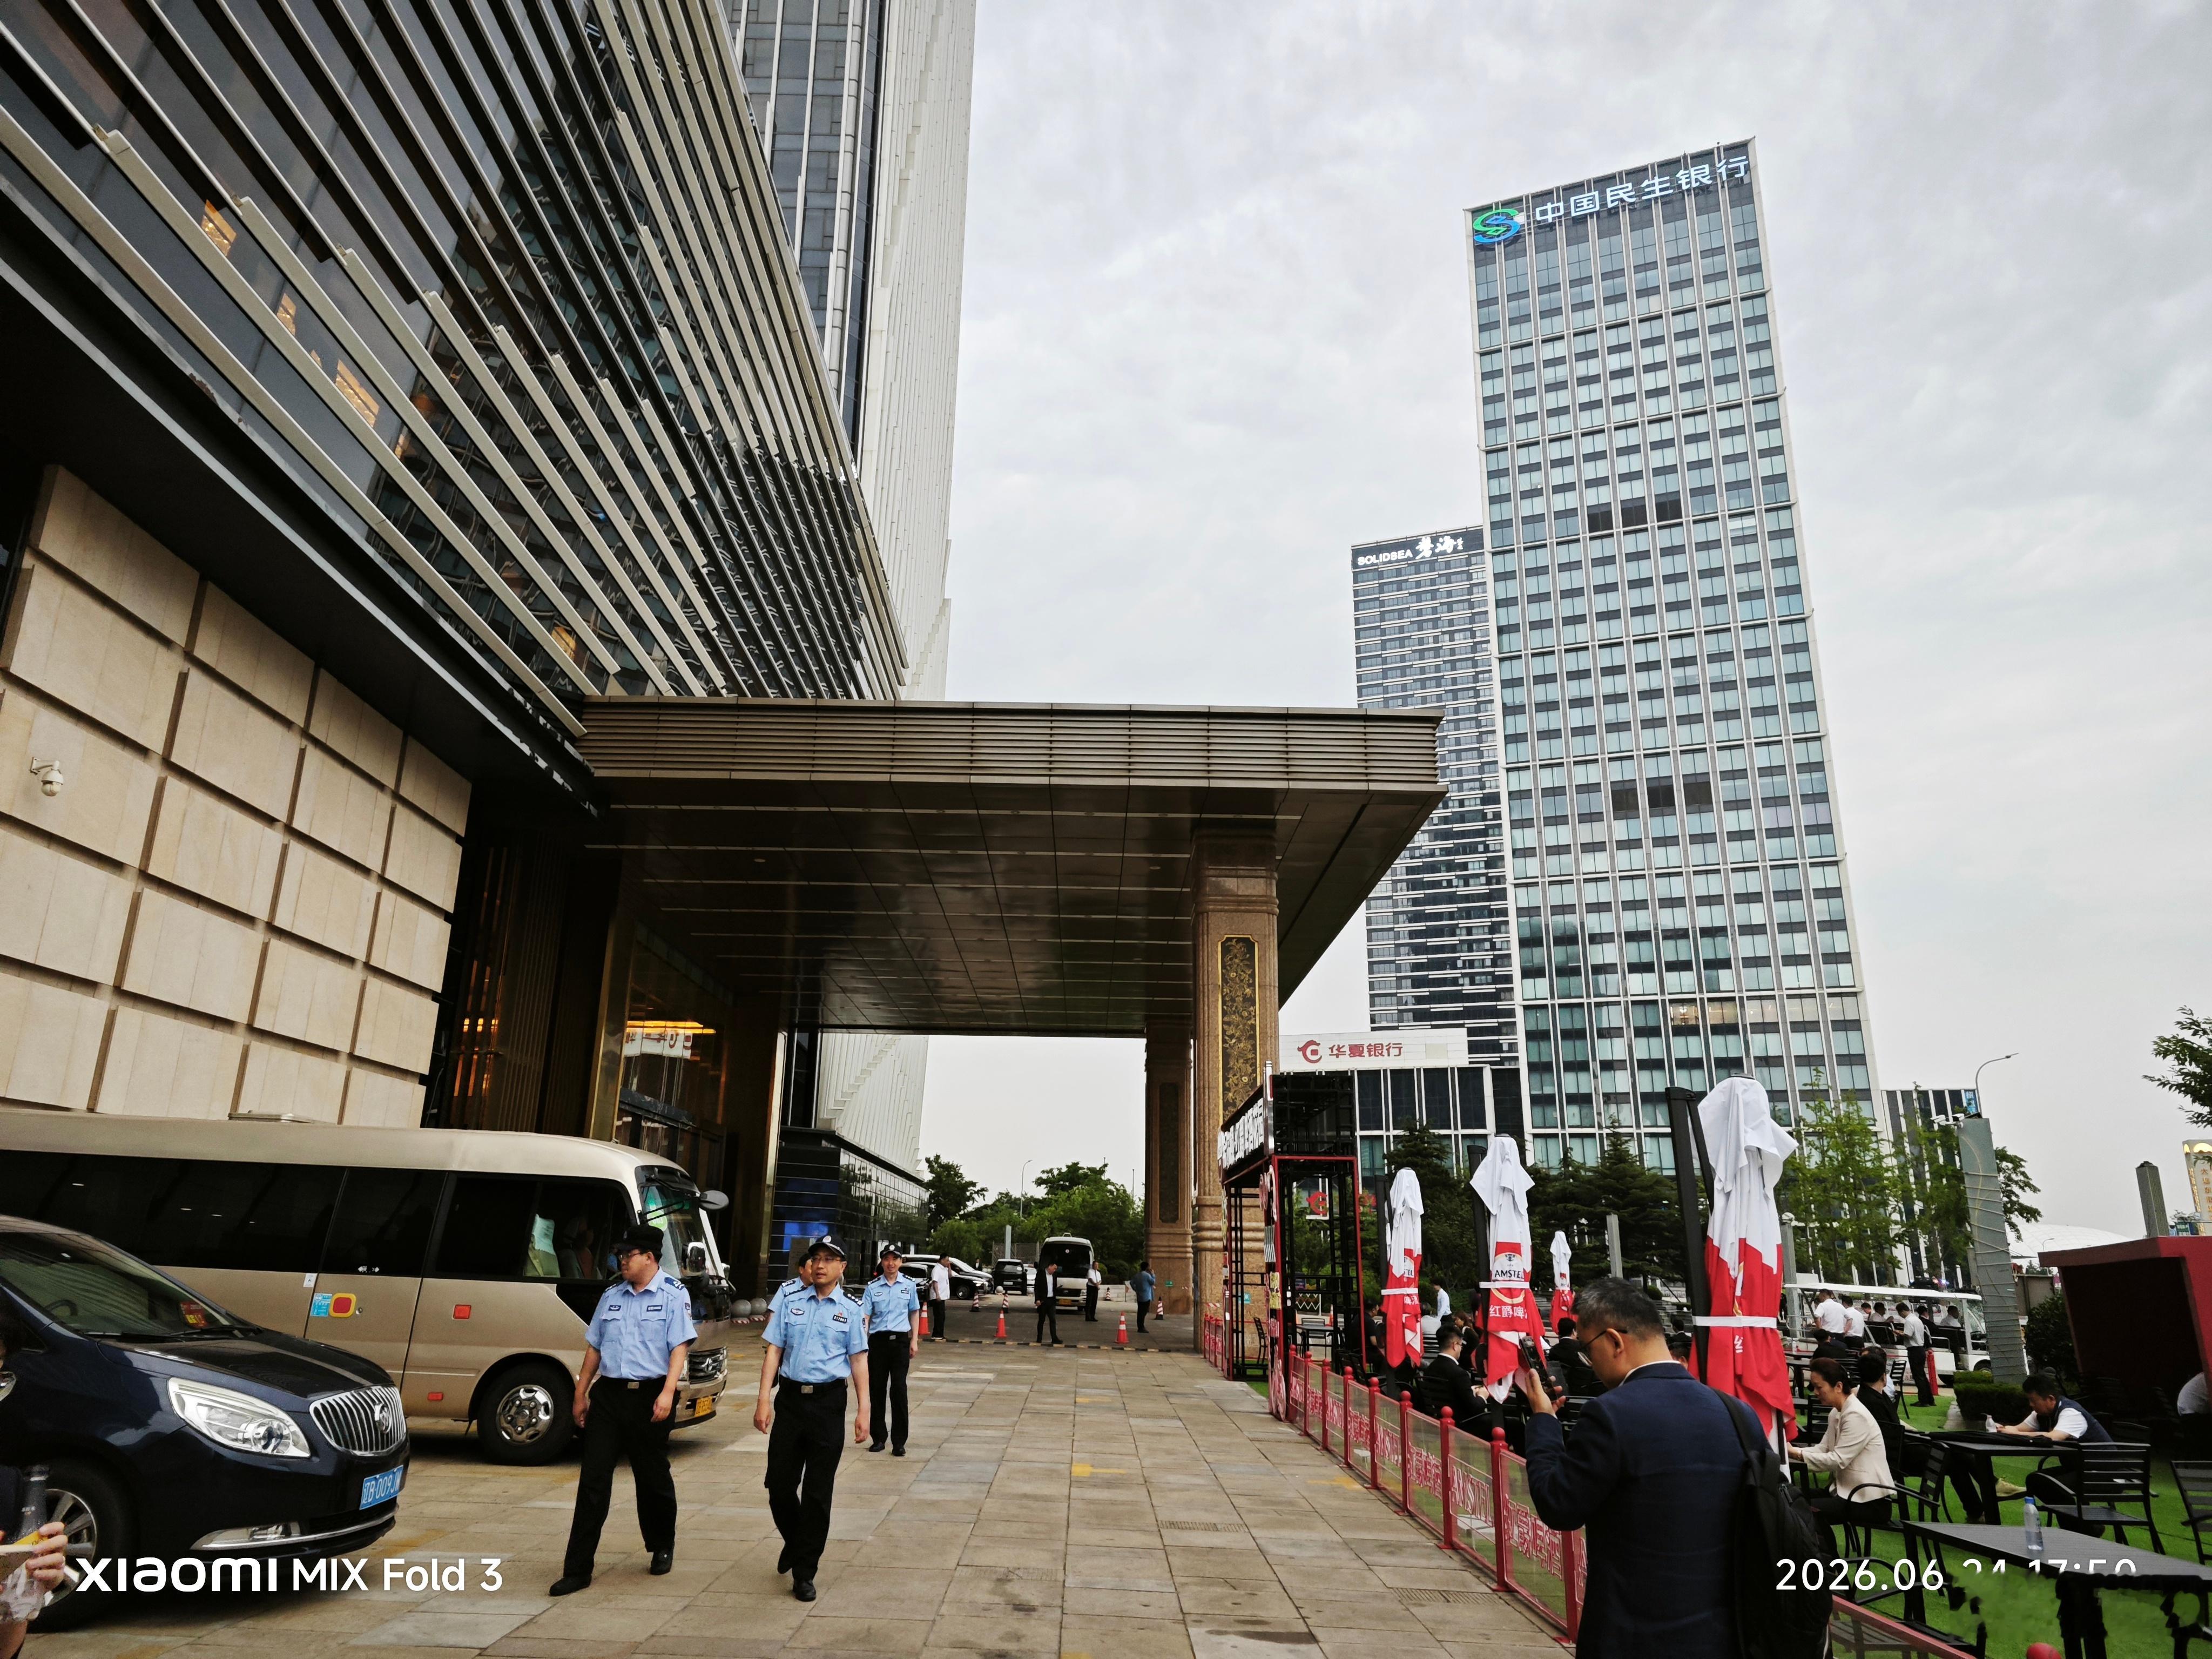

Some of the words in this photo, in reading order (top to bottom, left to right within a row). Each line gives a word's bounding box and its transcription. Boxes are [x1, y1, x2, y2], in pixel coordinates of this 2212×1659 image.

[1535, 156, 1749, 222] 中国民生银行
[1358, 549, 1413, 565] SOLIDSEA
[1329, 1042, 1403, 1058] 华夏银行
[1495, 1269, 1524, 1279] AMSTEL
[1451, 1466, 1495, 1528] AMSTEL
